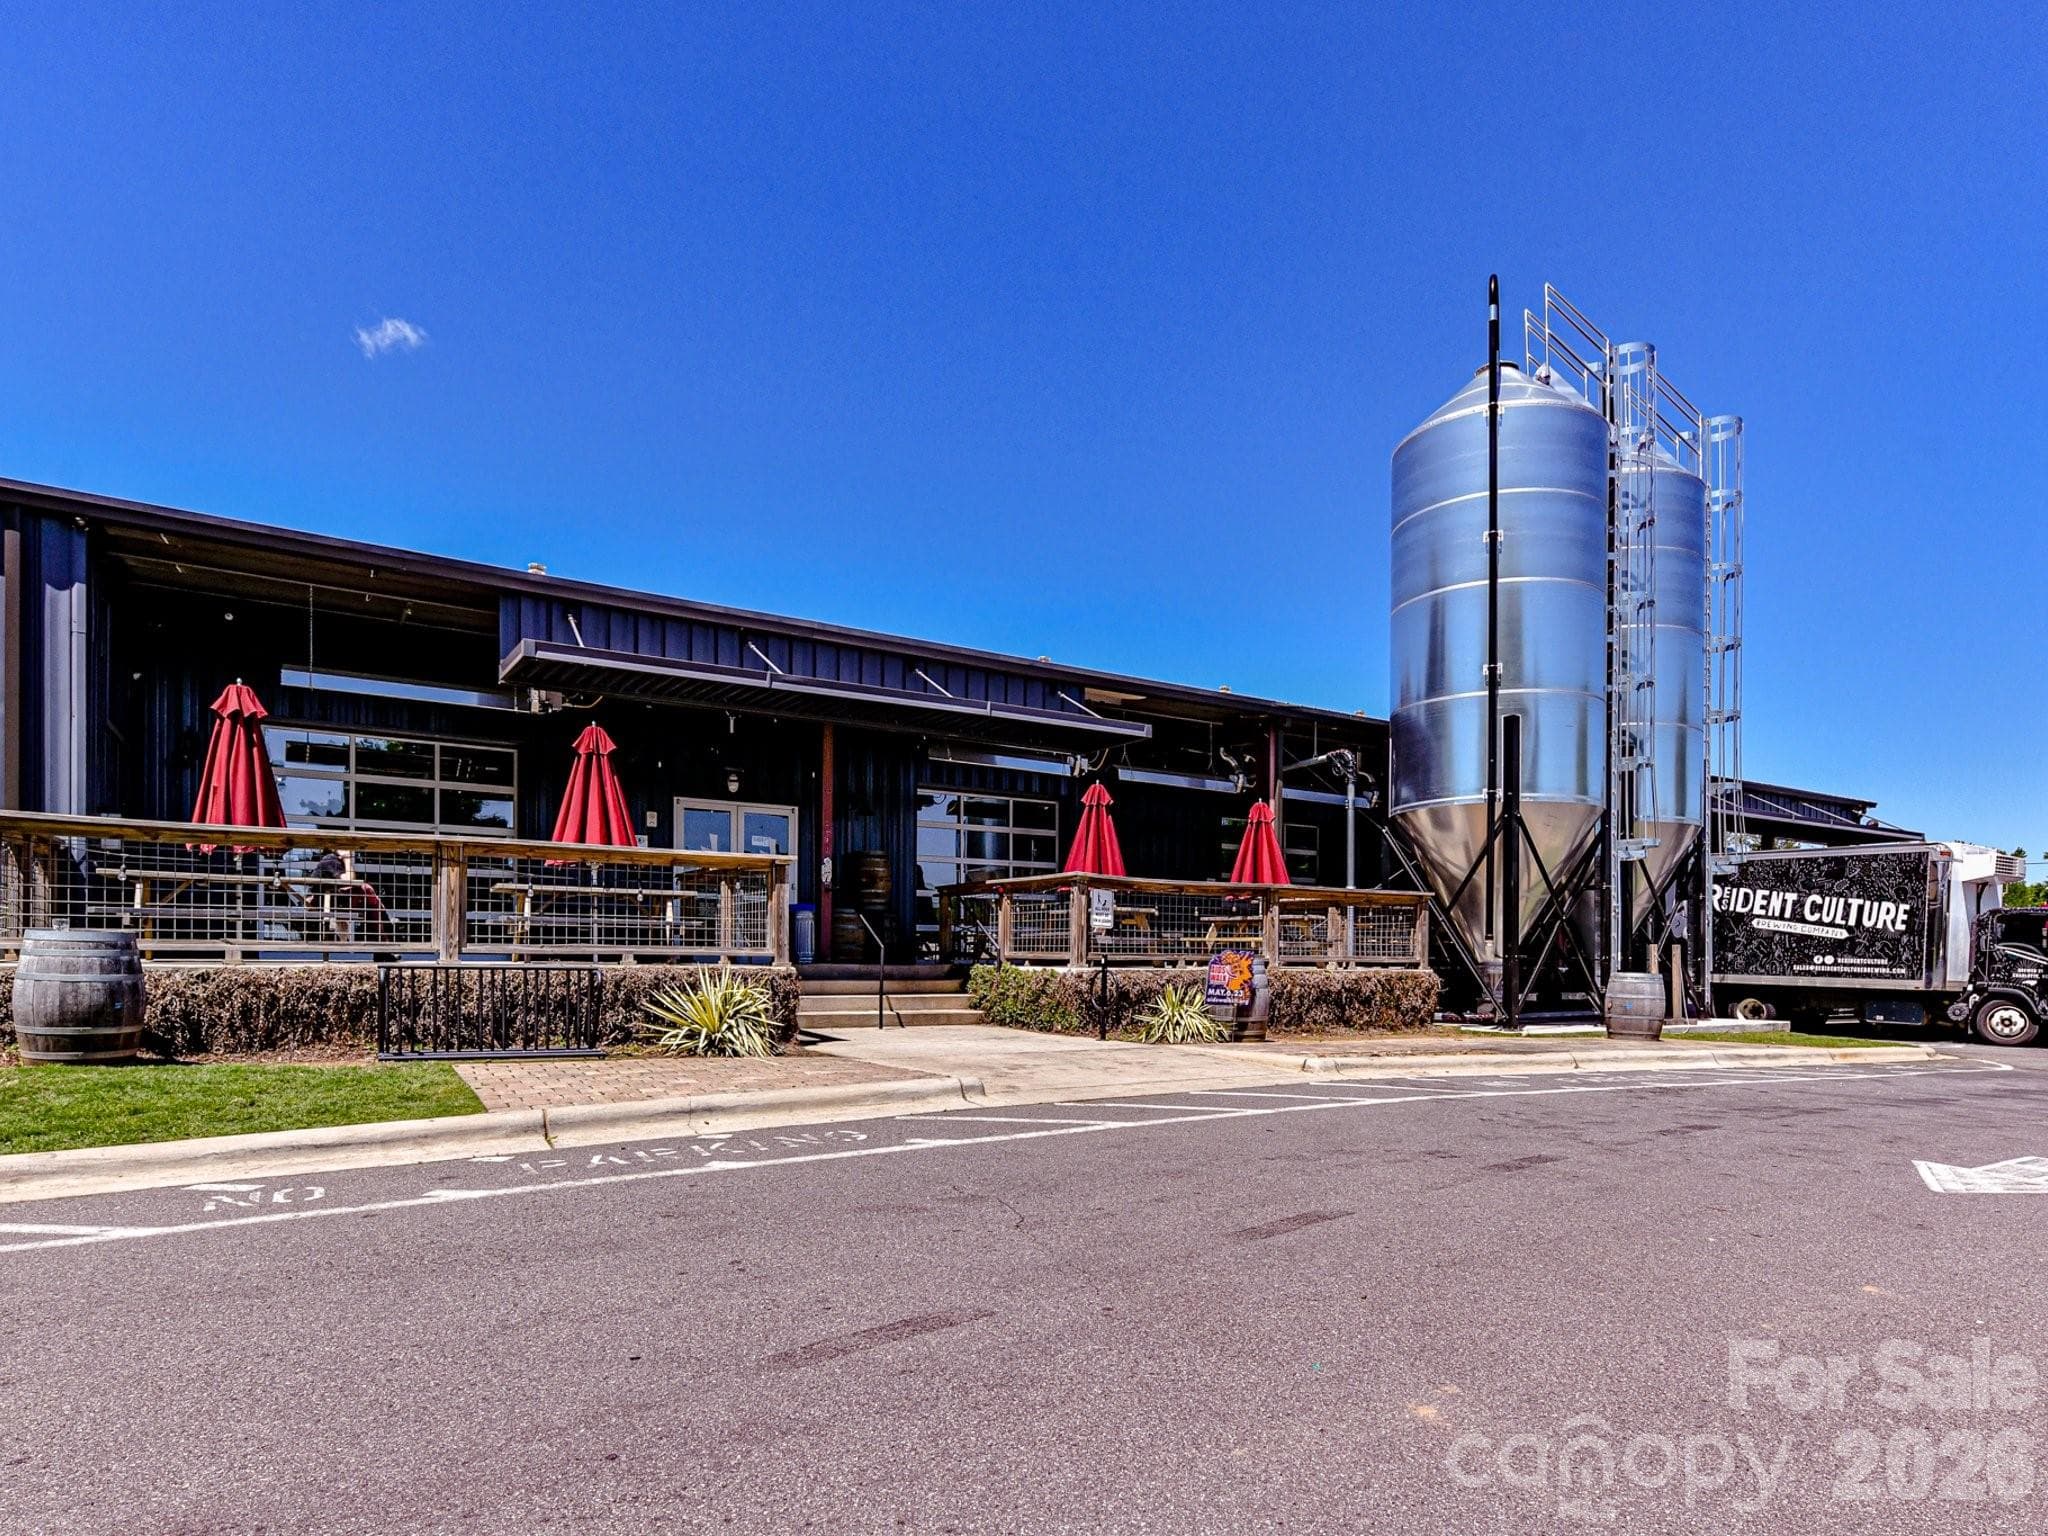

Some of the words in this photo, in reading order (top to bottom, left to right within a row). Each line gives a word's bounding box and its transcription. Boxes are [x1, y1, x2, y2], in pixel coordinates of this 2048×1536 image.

[1803, 894, 1910, 932] CULTURE
[203, 1185, 326, 1212] NO
[519, 1129, 868, 1175] PARKING
